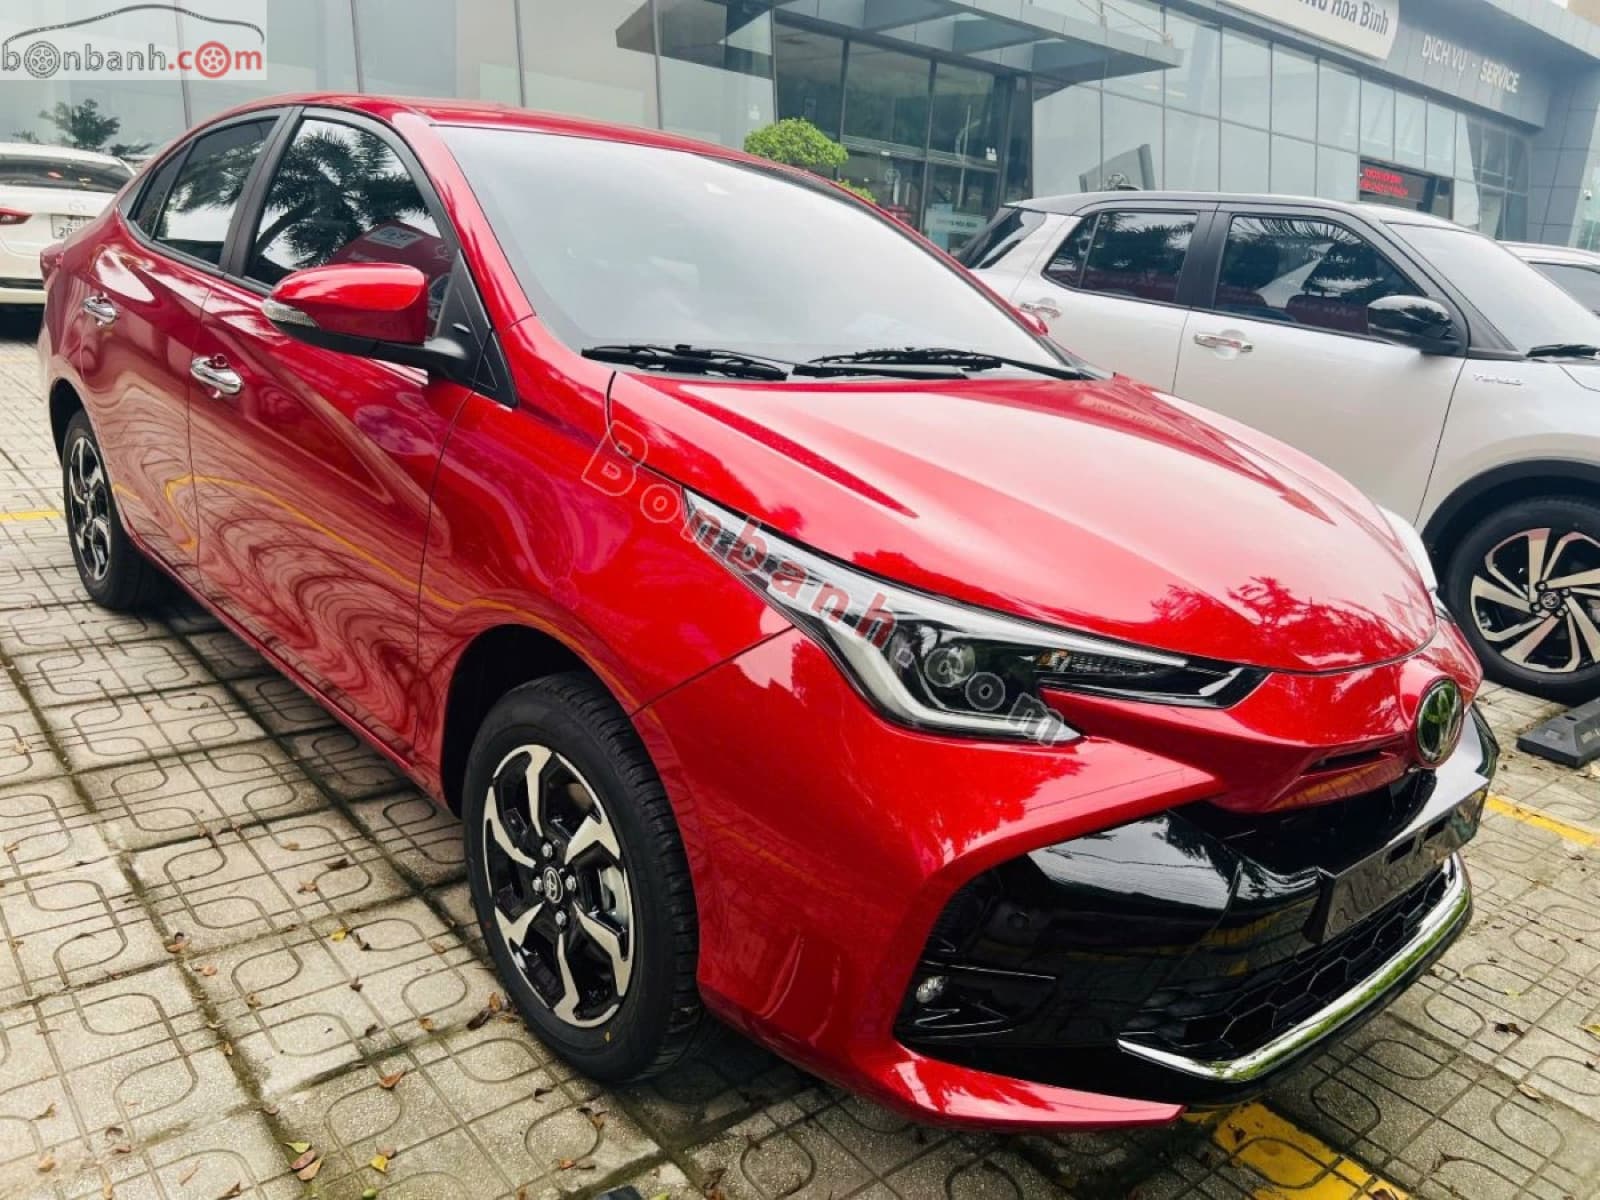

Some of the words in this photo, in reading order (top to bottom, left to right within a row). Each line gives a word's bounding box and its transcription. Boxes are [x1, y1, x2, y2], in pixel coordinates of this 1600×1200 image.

[1422, 34, 1451, 64] DỊCH
[1452, 47, 1469, 77] VỤ
[1480, 58, 1520, 93] SERVICE
